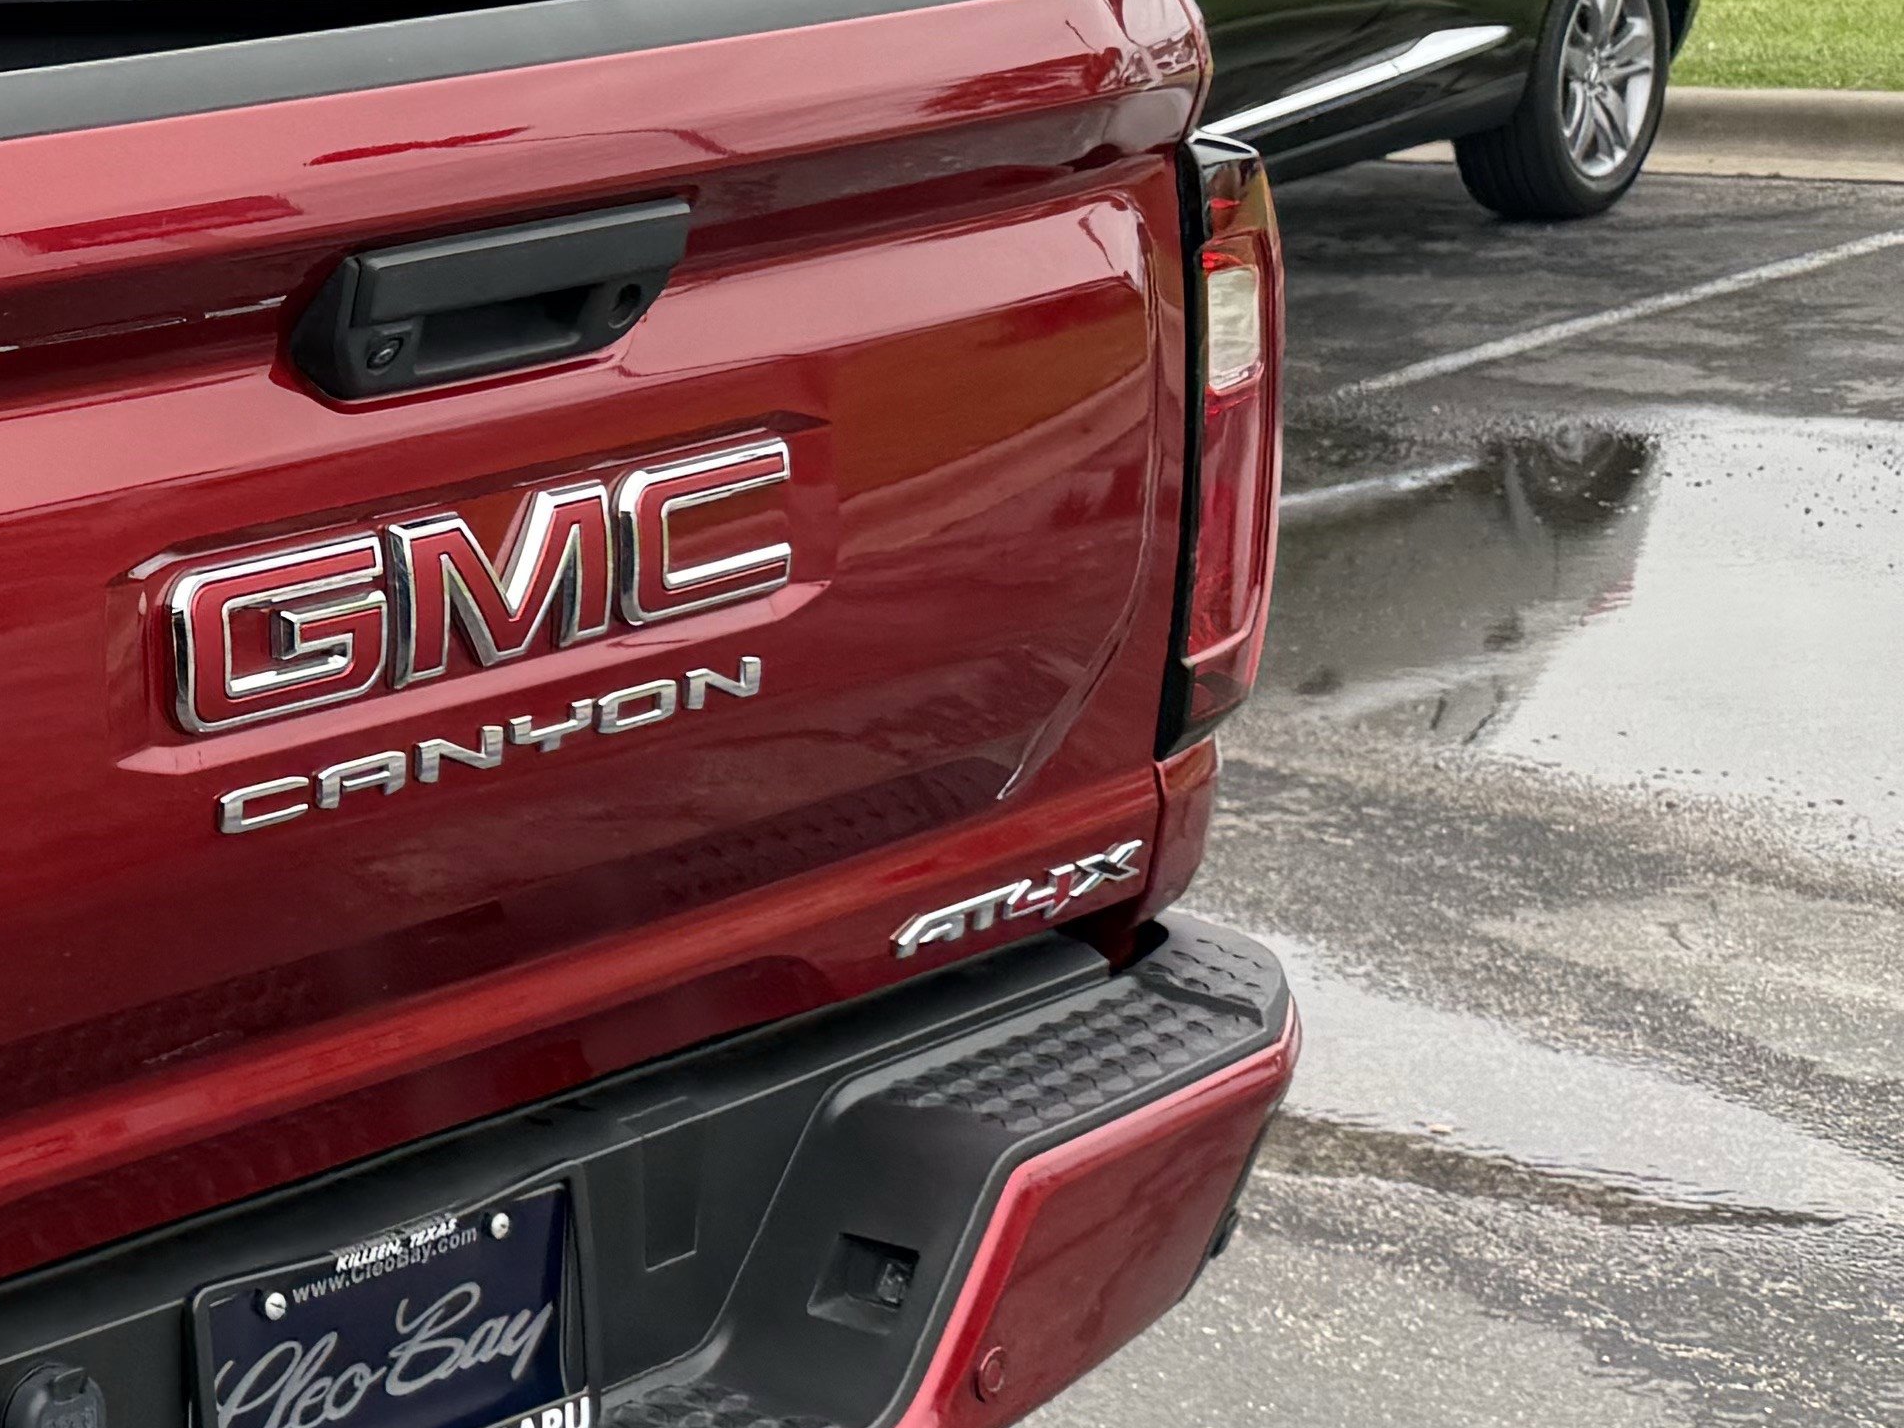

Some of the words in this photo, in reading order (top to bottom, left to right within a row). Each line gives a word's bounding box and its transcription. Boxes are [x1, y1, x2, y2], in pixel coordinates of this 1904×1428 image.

[172, 439, 792, 733] GMC
[219, 656, 761, 834] CANYON
[890, 839, 1142, 958] AT4X
[293, 1227, 477, 1304] www.CleoBay.com
[410, 1217, 457, 1248] TEXAS
[386, 1281, 553, 1396] Bay
